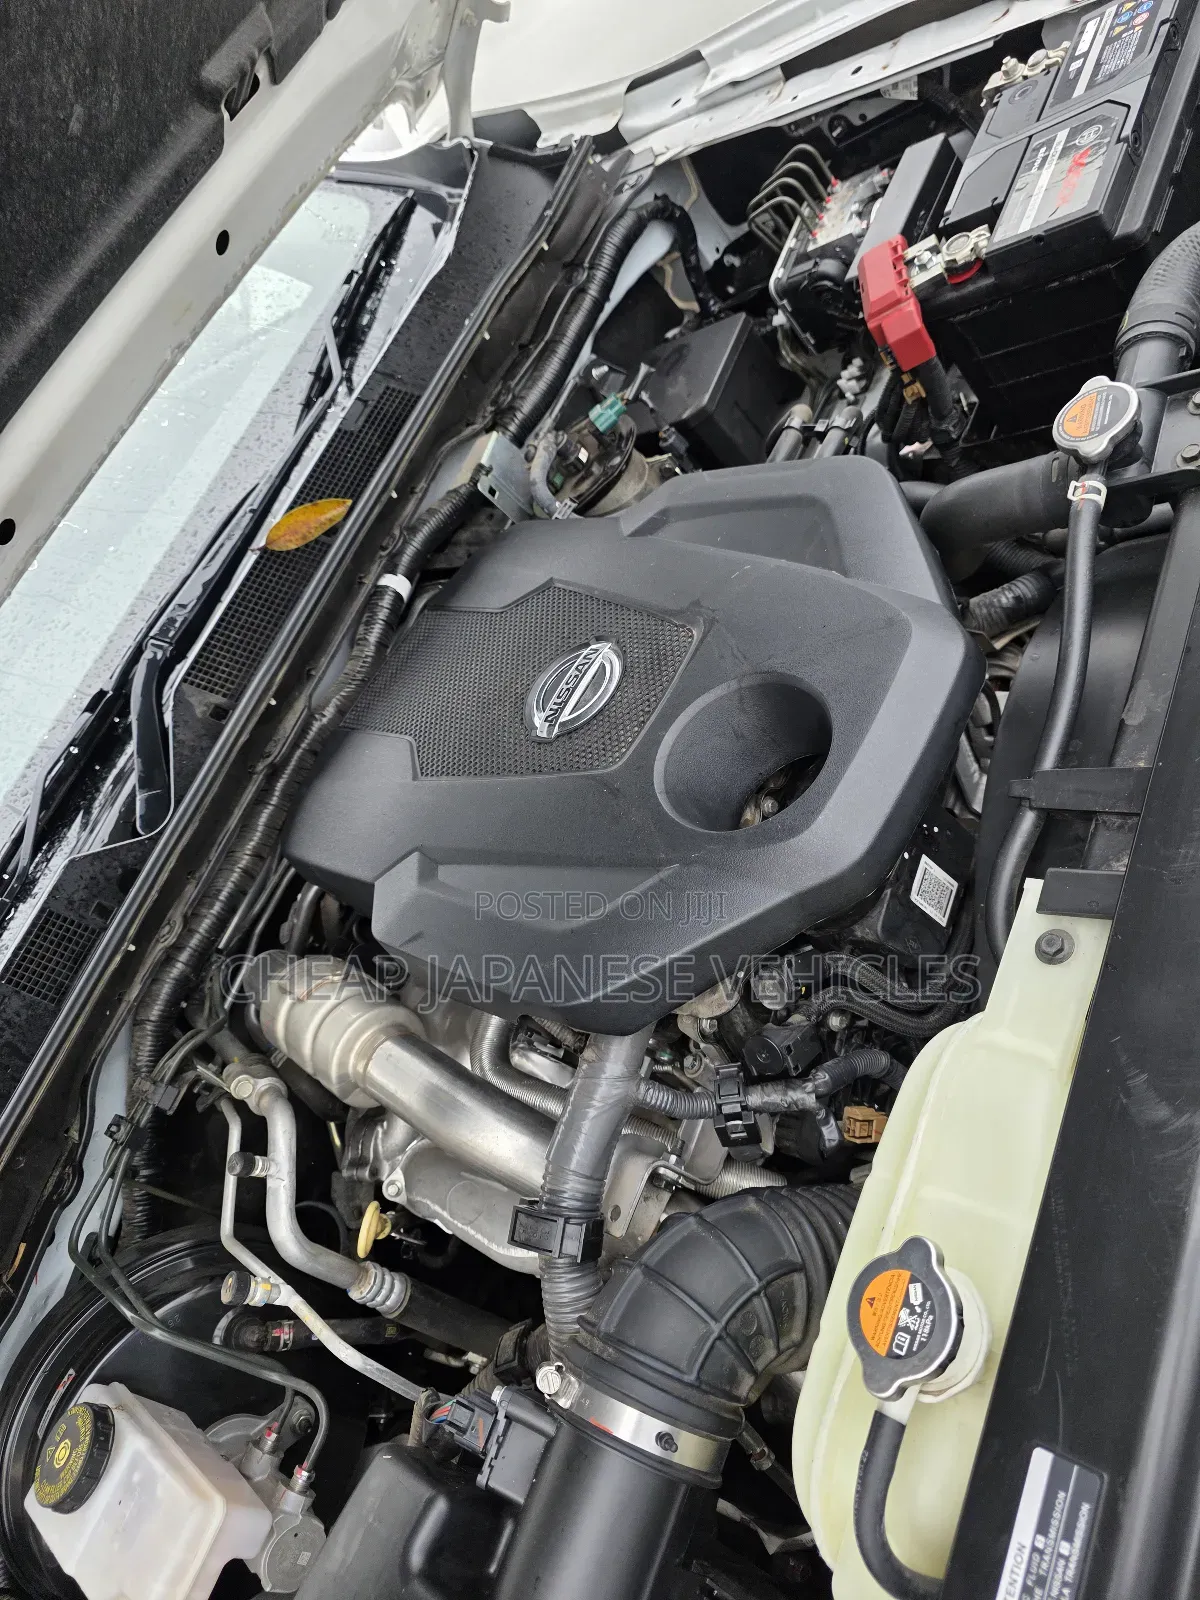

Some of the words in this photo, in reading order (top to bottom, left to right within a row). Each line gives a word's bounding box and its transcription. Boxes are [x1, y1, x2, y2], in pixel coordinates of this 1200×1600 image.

[543, 648, 600, 724] NISSAN
[1025, 1551, 1041, 1587] FLUID
[1039, 1490, 1067, 1576] TRANSMISSION
[1063, 1501, 1092, 1583] TRANSMISSION
[1049, 1558, 1067, 1599] NISSAN
